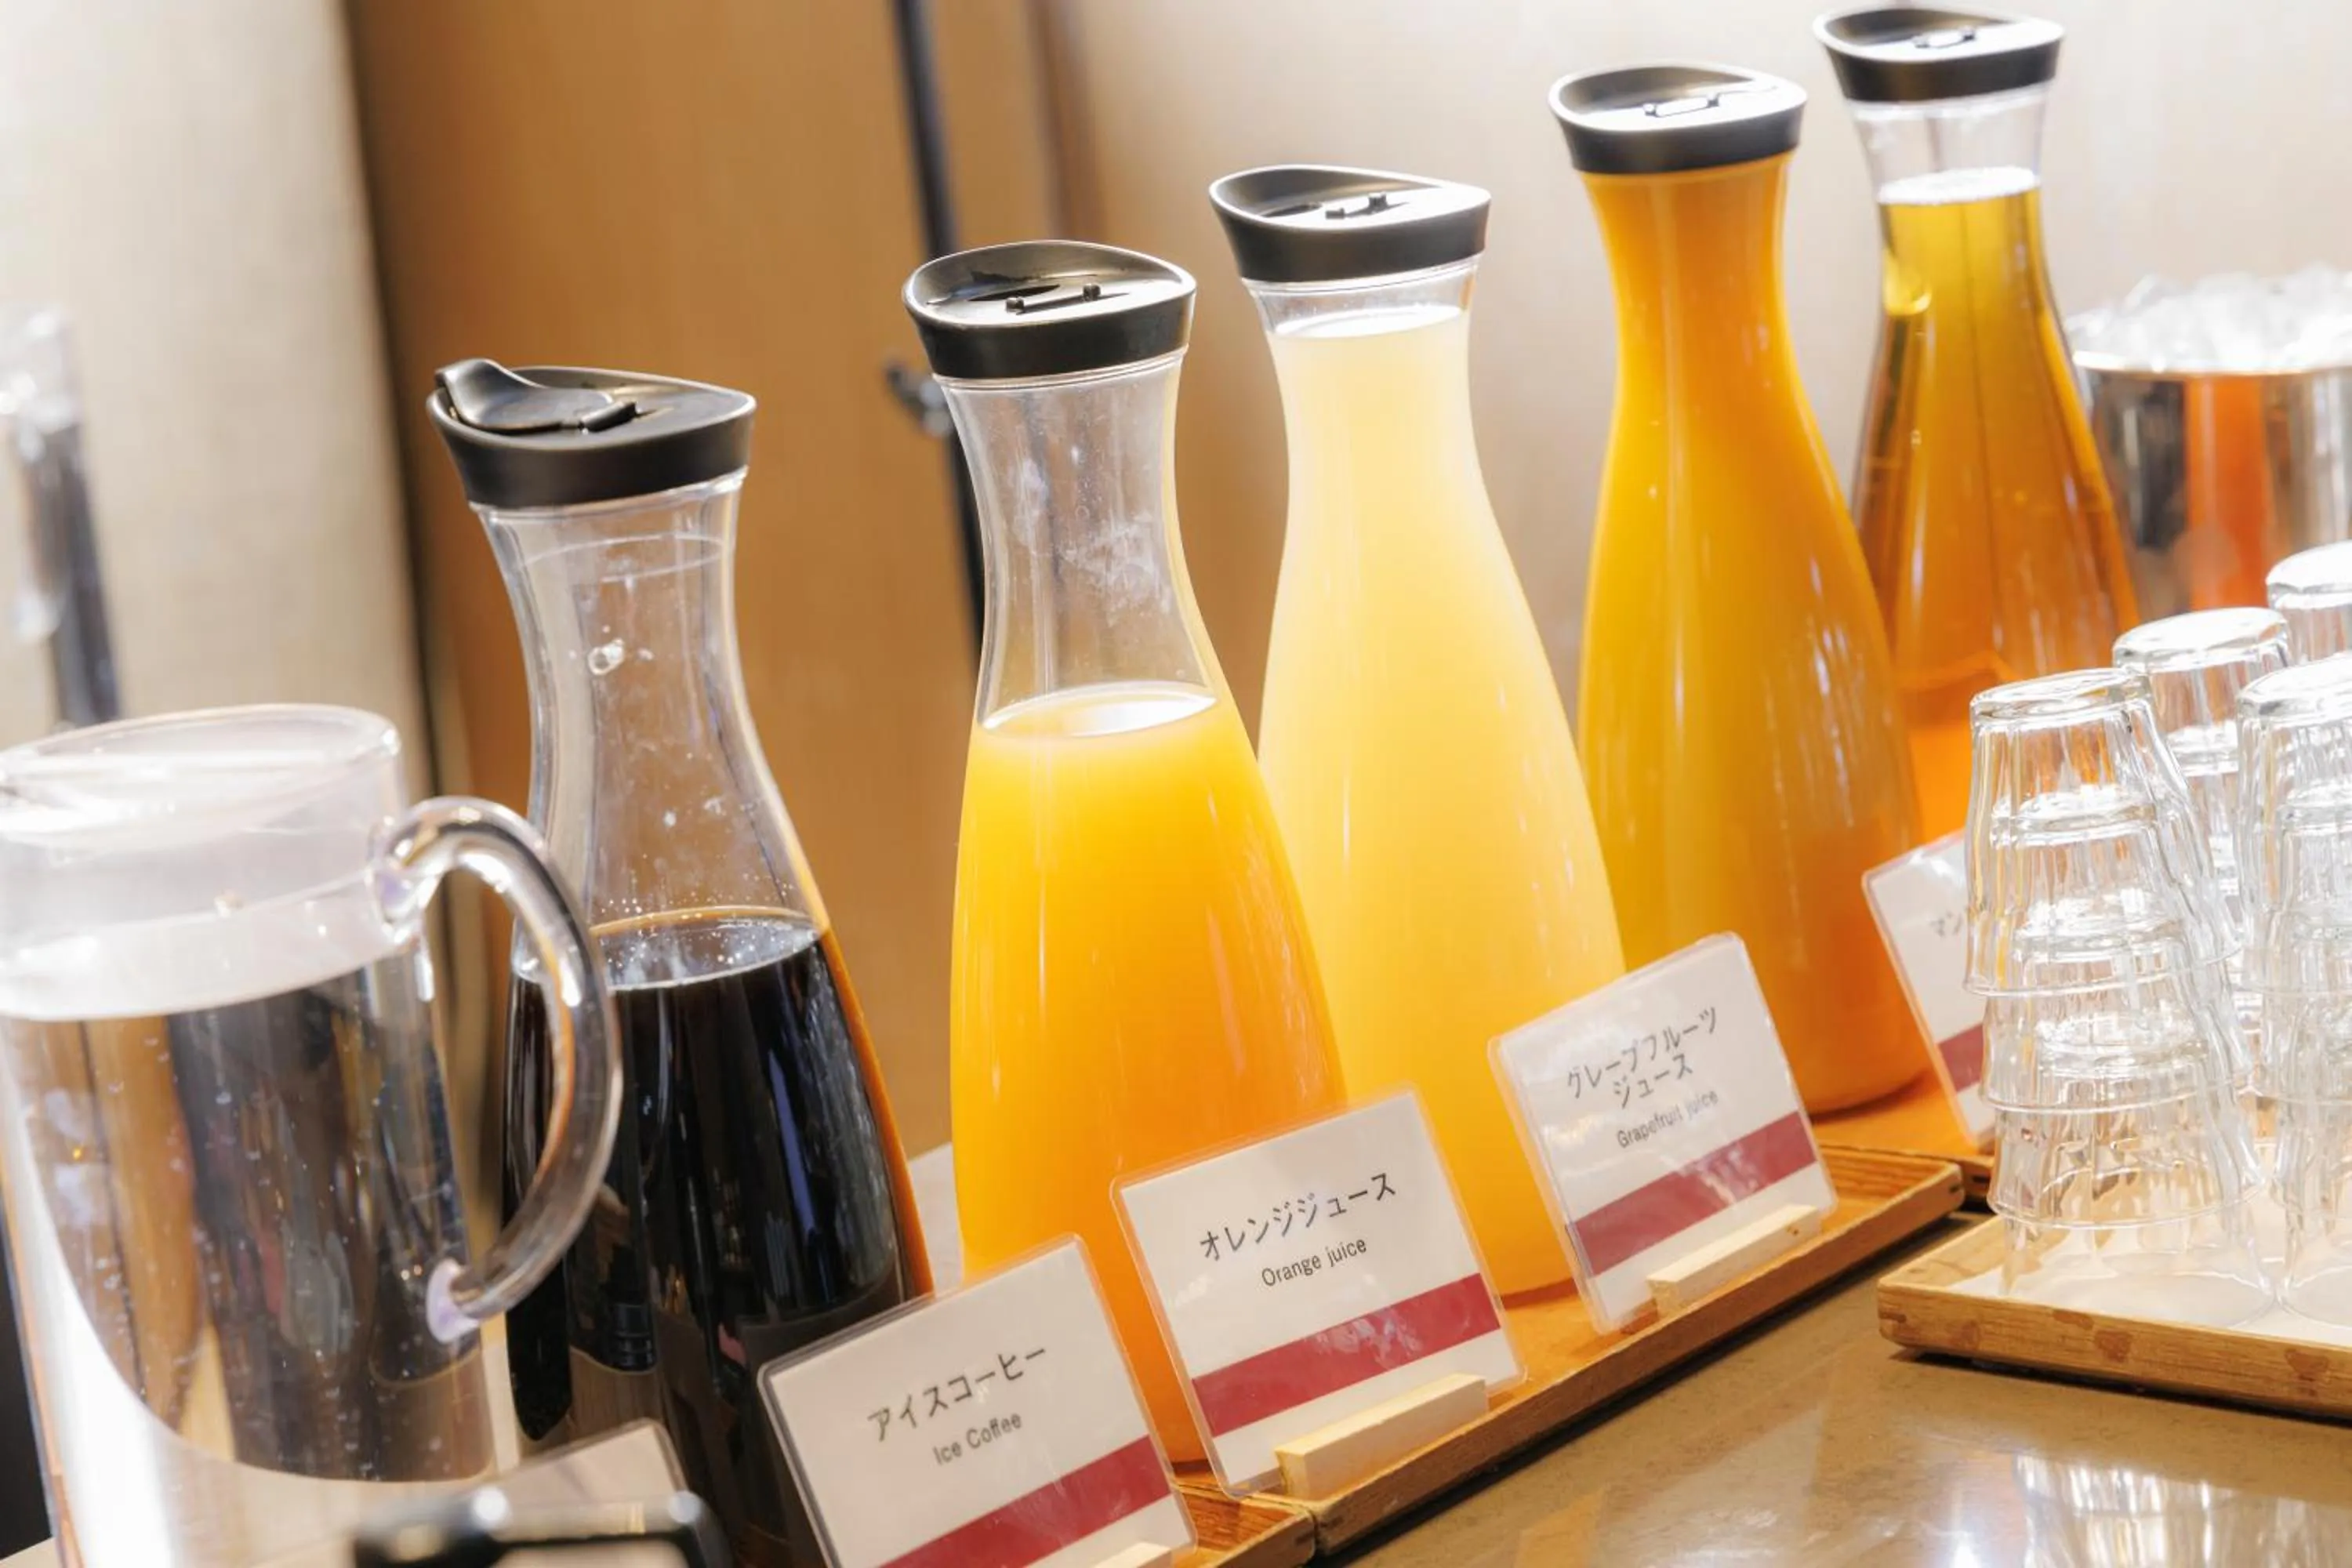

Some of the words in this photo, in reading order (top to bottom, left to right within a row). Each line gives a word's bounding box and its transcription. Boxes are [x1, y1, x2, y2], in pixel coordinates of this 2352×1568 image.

[1568, 1007, 1716, 1099] グレープフルーツ
[1613, 1054, 1693, 1110] ジュース
[1617, 1103, 1683, 1149] Grapefruit
[1200, 1172, 1396, 1261] オレンジジュース
[1261, 1256, 1322, 1287] Orange
[1327, 1236, 1367, 1266] juice
[868, 1347, 1046, 1443] アイスコーヒー
[933, 1440, 963, 1466] Ice
[966, 1413, 1022, 1450] Coffee
